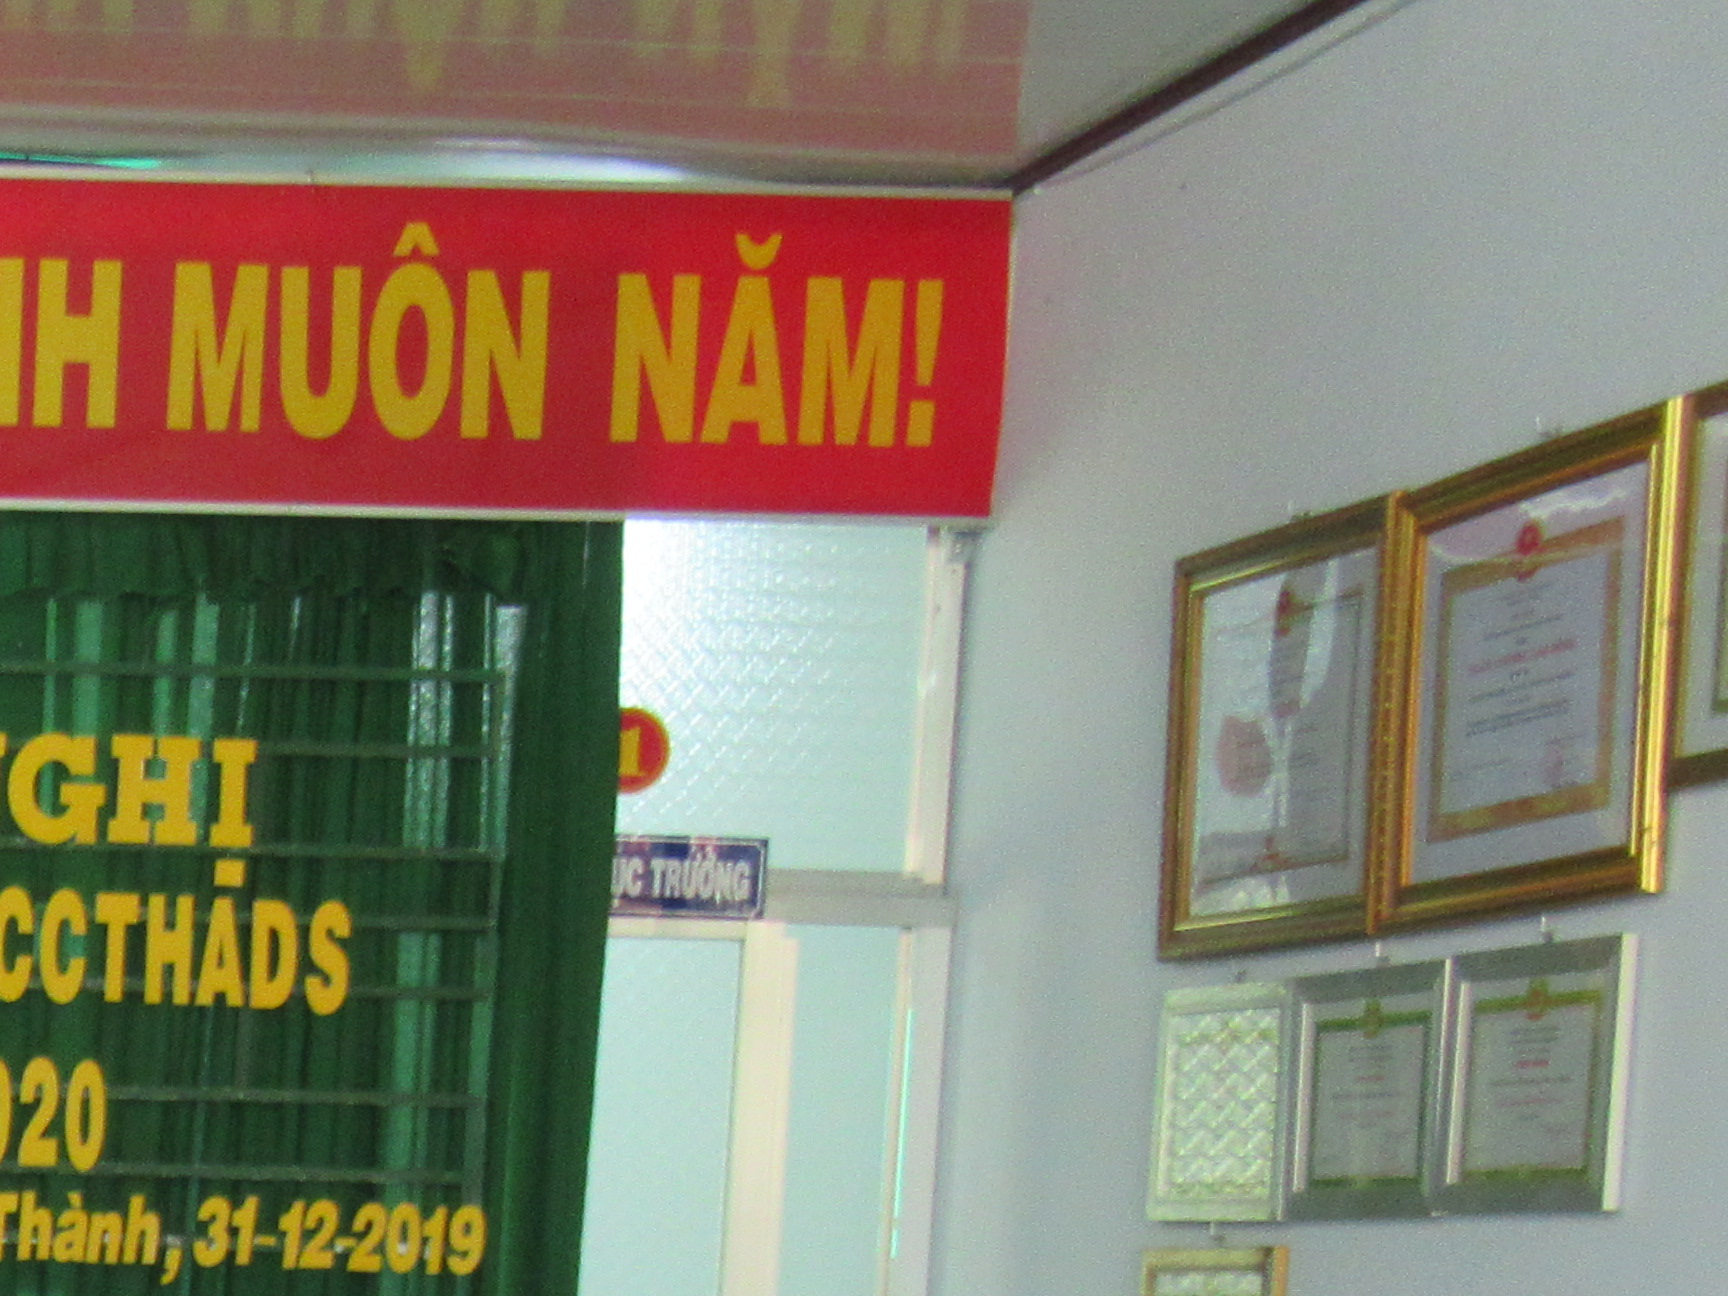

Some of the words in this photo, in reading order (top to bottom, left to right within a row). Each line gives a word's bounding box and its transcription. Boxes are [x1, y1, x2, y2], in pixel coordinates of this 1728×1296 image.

[168, 223, 549, 440] MUÔN
[611, 234, 944, 448] NĂM!
[193, 1195, 487, 1276] 31-12-2019
